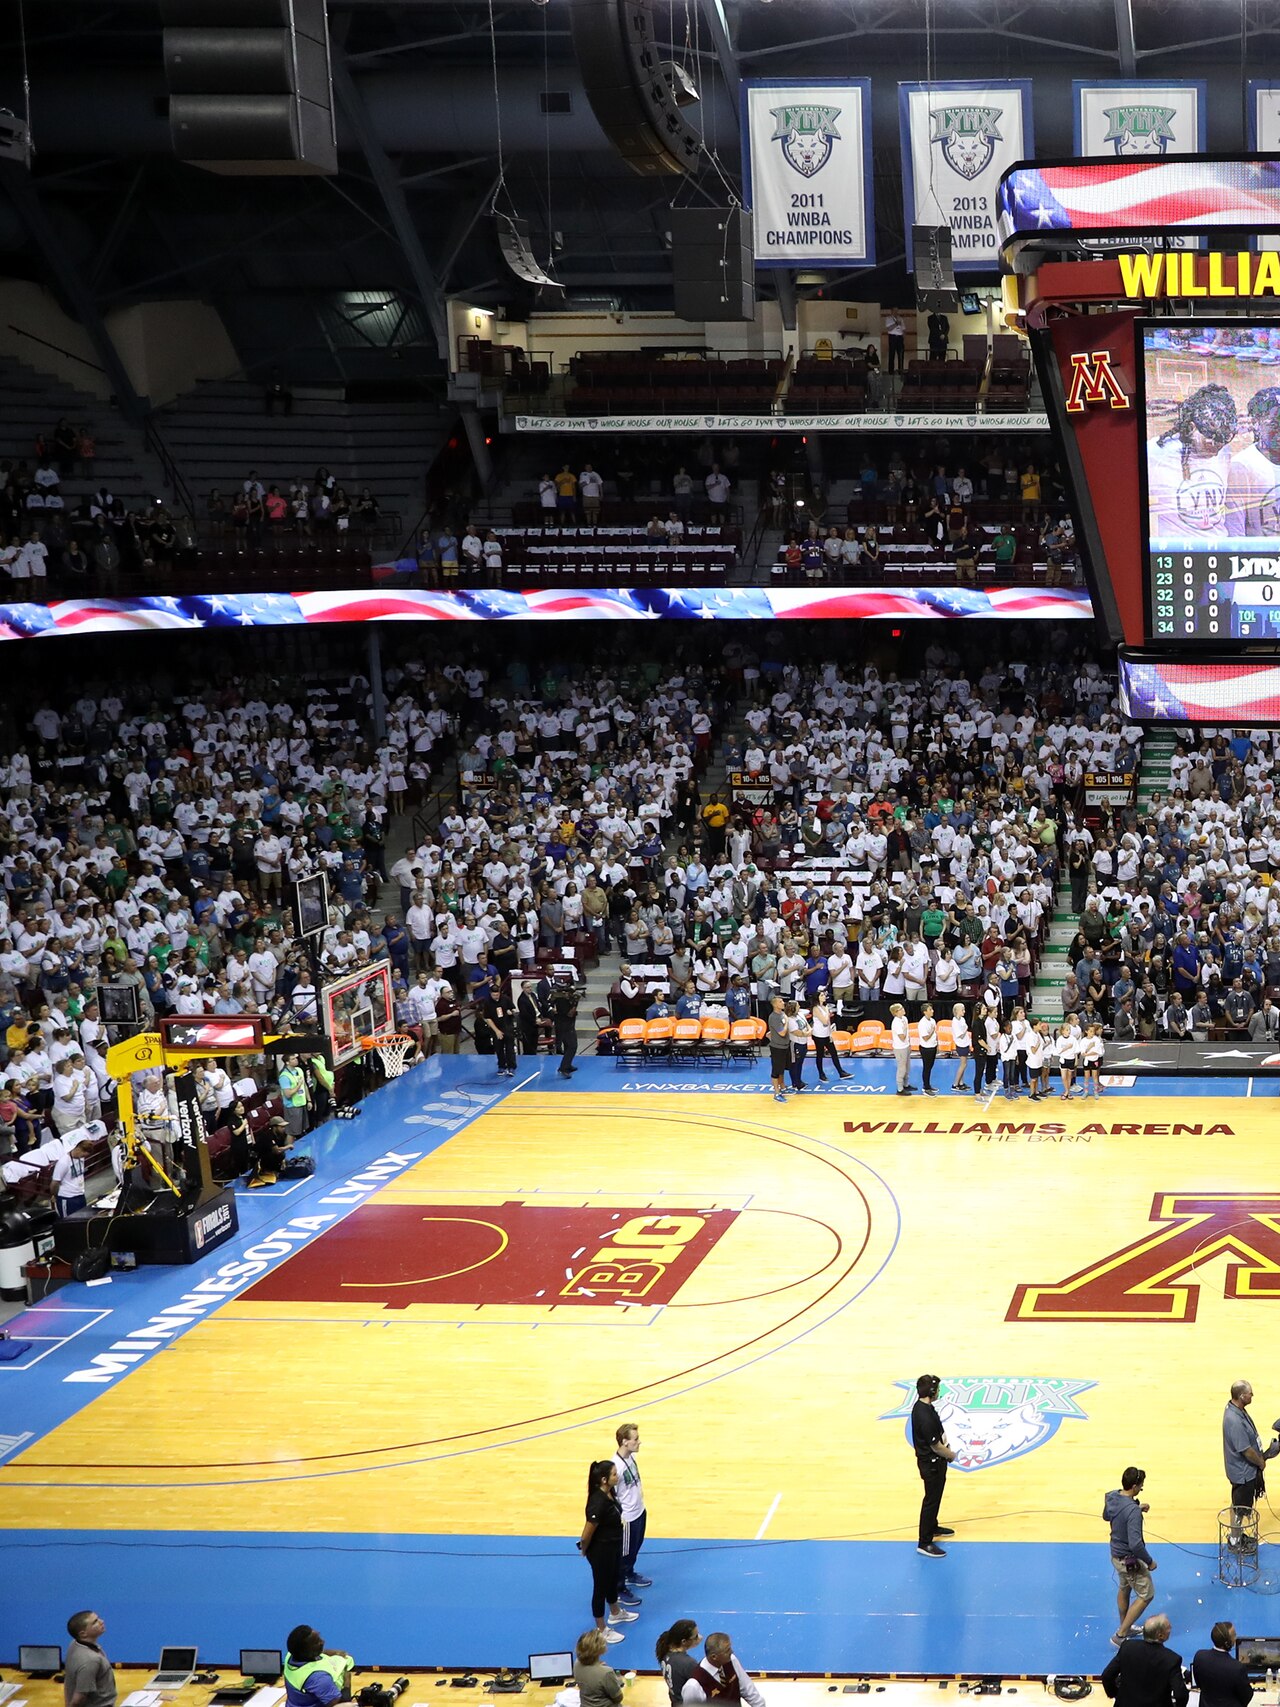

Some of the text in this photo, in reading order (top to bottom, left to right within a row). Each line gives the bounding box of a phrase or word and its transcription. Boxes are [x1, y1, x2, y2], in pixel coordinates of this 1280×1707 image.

[772, 109, 840, 136] LYNX
[932, 111, 1000, 137] LYNX
[1107, 109, 1174, 137] LYNX
[791, 193, 824, 207] 2011
[953, 197, 987, 211] 2013
[787, 212, 830, 226] WNBA
[949, 215, 993, 229] WNBA
[766, 230, 852, 246] CHAMPIONS
[1065, 351, 1130, 412] M
[1157, 556, 1217, 568] 13 0 0
[1156, 573, 1218, 585] 23 0 0
[1157, 589, 1218, 601] 32 0 0
[1262, 584, 1273, 601] 0
[1157, 605, 1218, 617] 33 0 0
[1239, 610, 1256, 621] TOL
[1158, 621, 1218, 633] 34 0 0
[1241, 624, 1250, 635] 3
[759, 775, 770, 783] 105
[1095, 774, 1123, 783] 105 106
[178, 1100, 196, 1149] verizon
[843, 1121, 1236, 1136] WILLIAMS ARENA
[975, 1135, 1093, 1143] THE BARN
[62, 1151, 423, 1383] MINNESOTA LYNX
